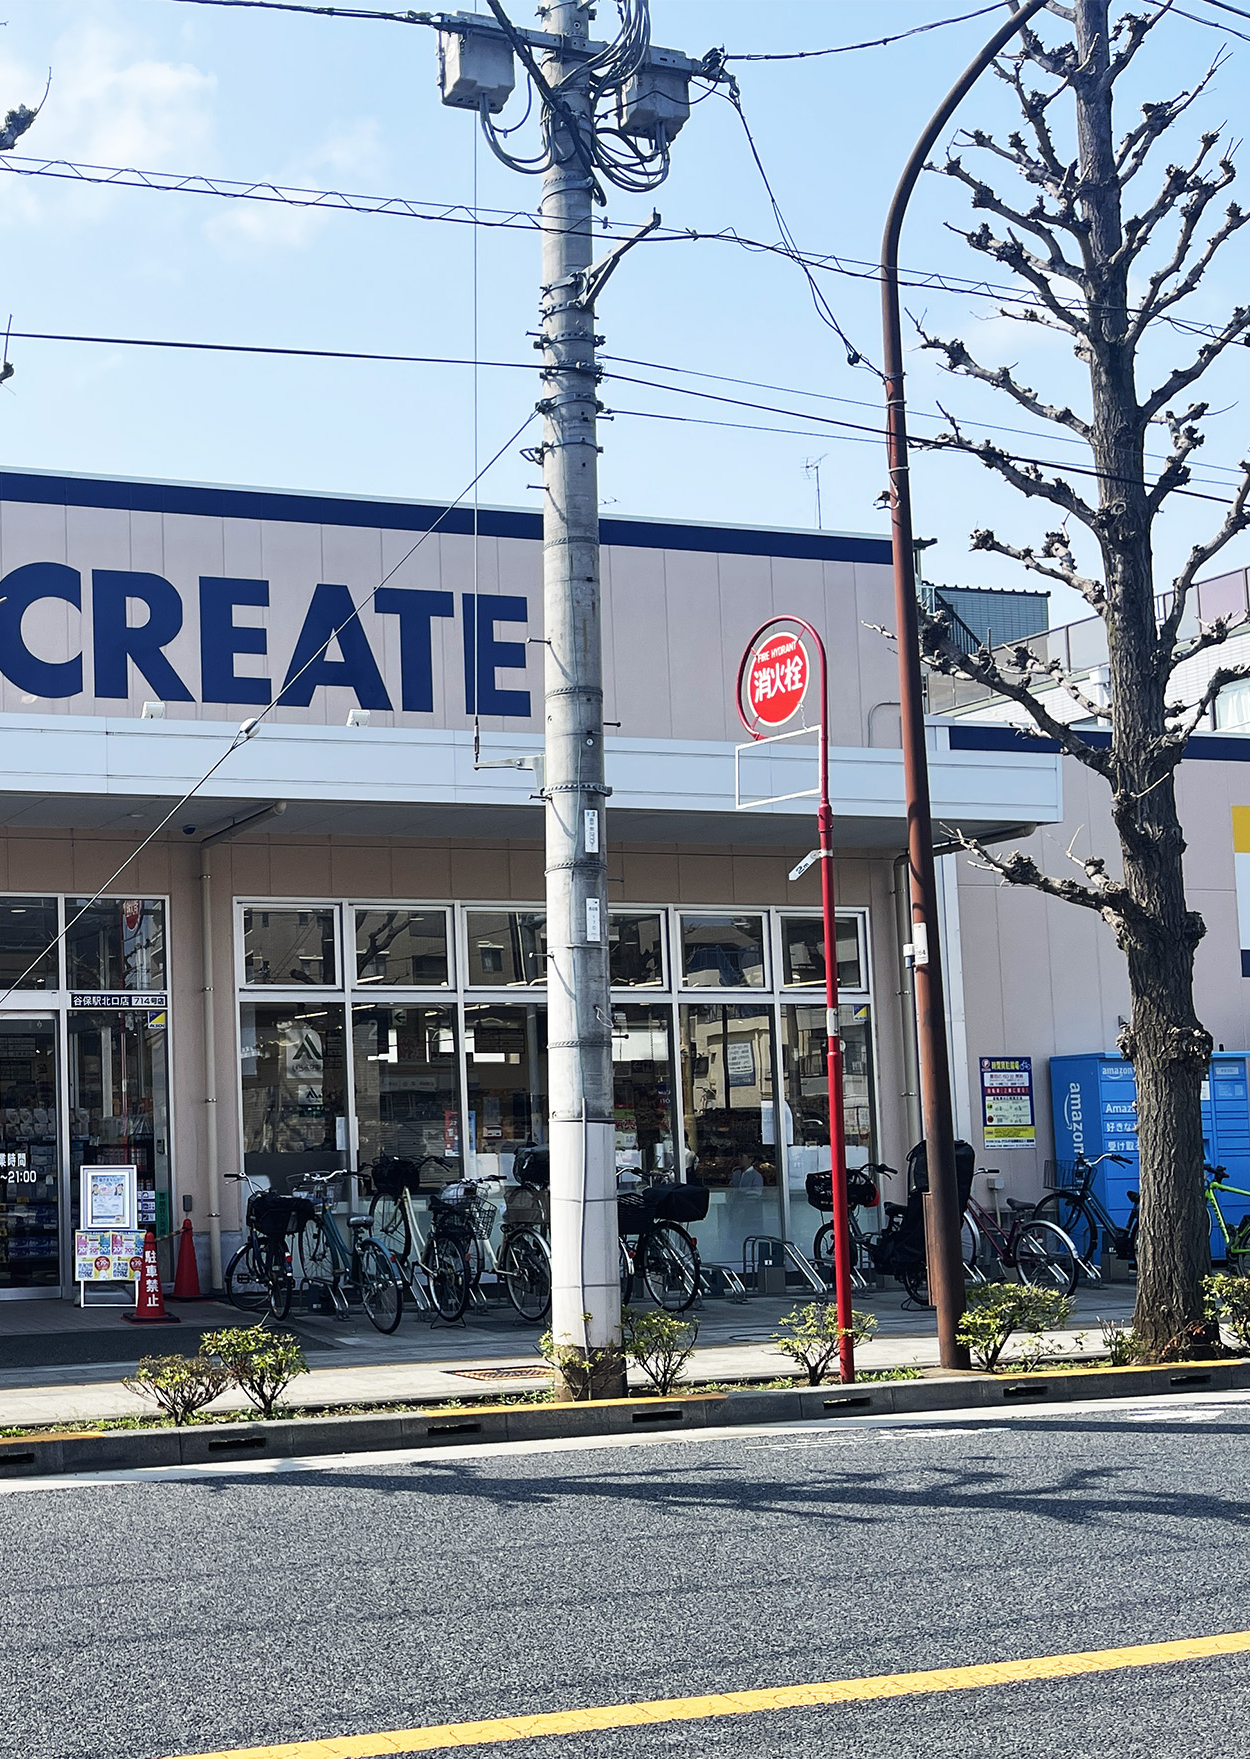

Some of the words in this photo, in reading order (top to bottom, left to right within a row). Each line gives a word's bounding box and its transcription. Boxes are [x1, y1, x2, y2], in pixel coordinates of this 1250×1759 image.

[757, 651, 770, 664] FIRE
[770, 641, 797, 659] HYDRANT
[753, 655, 803, 704] 消火栓
[73, 995, 130, 1006] 谷保駅北口店
[1102, 1067, 1133, 1076] amazon
[1069, 1082, 1085, 1154] amazon
[145, 1250, 160, 1308] 駐車禁止
